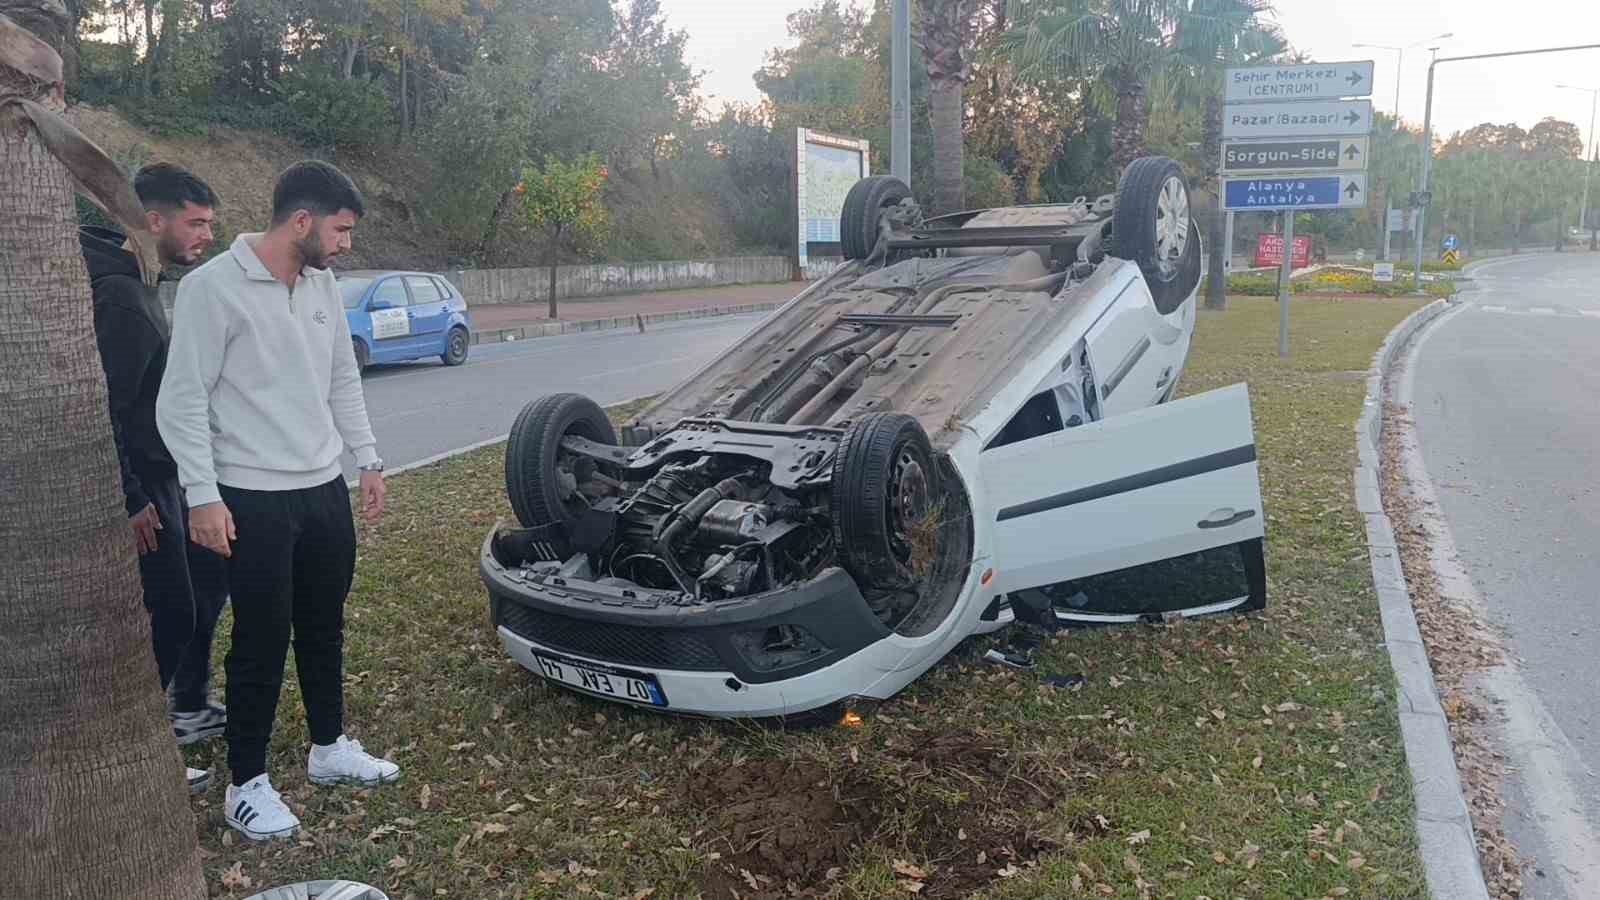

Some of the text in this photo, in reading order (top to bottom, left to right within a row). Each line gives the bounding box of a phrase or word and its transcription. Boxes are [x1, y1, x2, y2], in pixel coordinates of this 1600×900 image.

[1276, 68, 1337, 81] Merkezi
[1249, 82, 1319, 97] (CENTRUM)
[1227, 148, 1336, 164] Sorgun-Side
[1248, 181, 1305, 191] Alanya
[1247, 193, 1315, 205] Antalya
[542, 658, 563, 679] 44
[576, 668, 614, 693] EAK
[627, 679, 649, 699] 07
